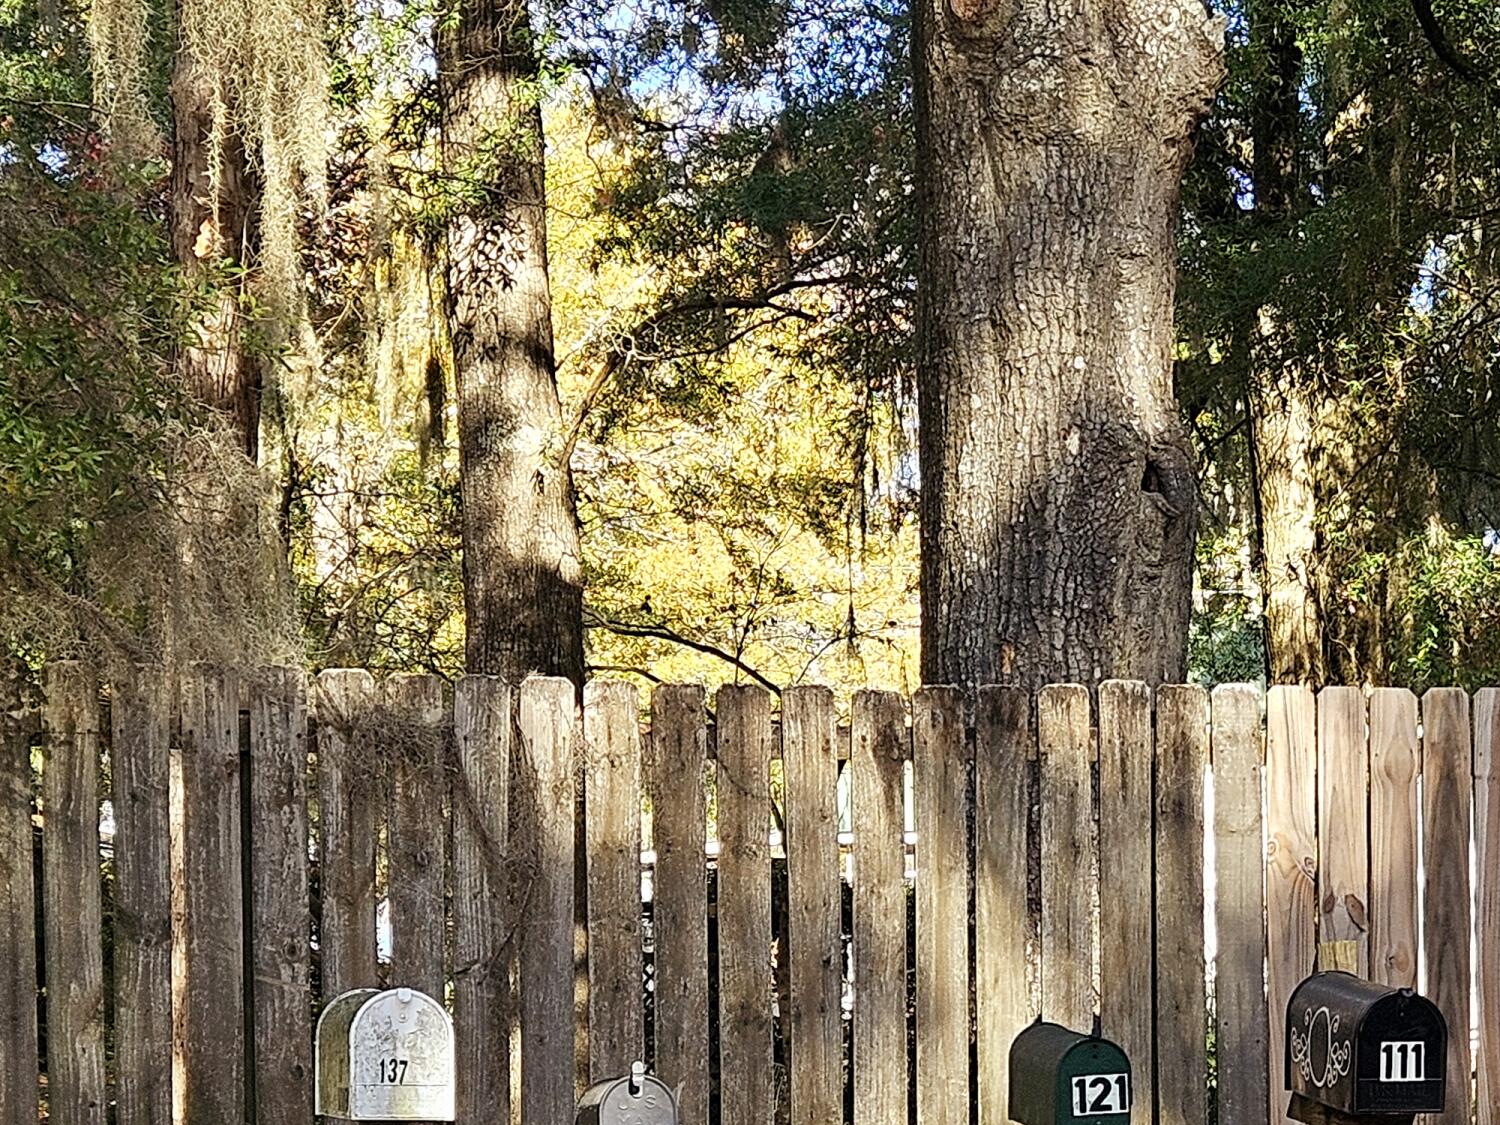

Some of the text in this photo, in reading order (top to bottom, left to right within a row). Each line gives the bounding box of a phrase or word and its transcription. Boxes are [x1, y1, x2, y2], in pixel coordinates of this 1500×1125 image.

[379, 1058, 408, 1085] 137
[1381, 1043, 1422, 1080] 111
[1074, 1075, 1127, 1113] 121
